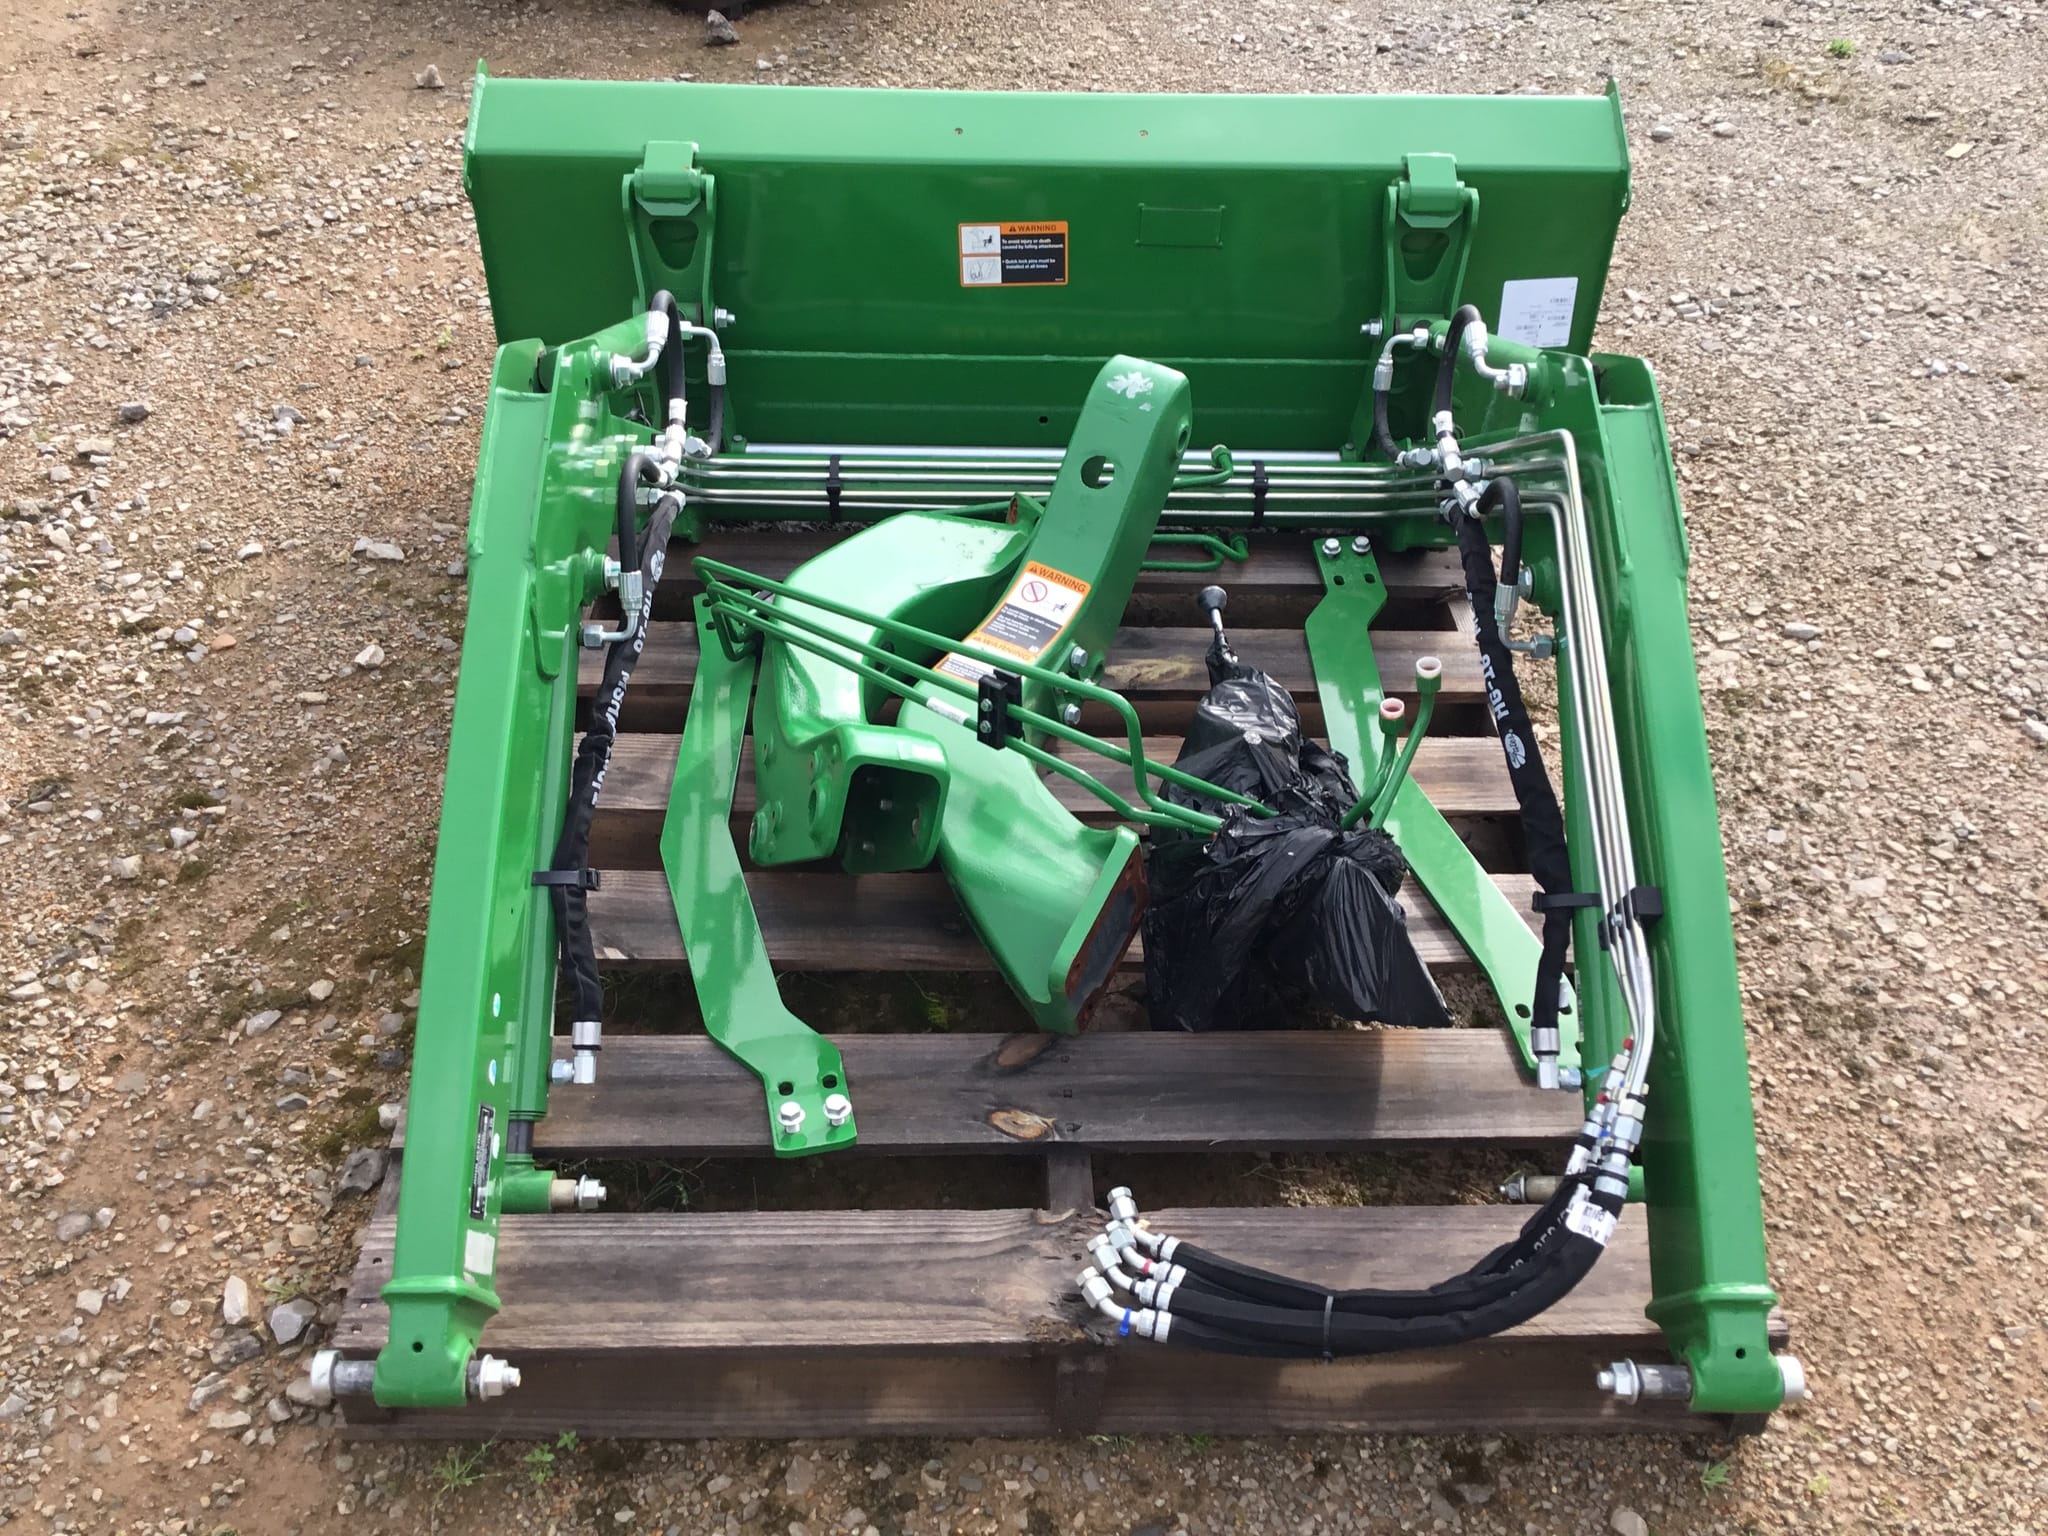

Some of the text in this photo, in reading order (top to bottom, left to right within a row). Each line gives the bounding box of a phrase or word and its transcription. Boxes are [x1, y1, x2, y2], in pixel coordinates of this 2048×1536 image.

[1018, 224, 1056, 232] WARNING
[1039, 566, 1087, 593] WARNING
[985, 638, 1032, 661] WARNING
